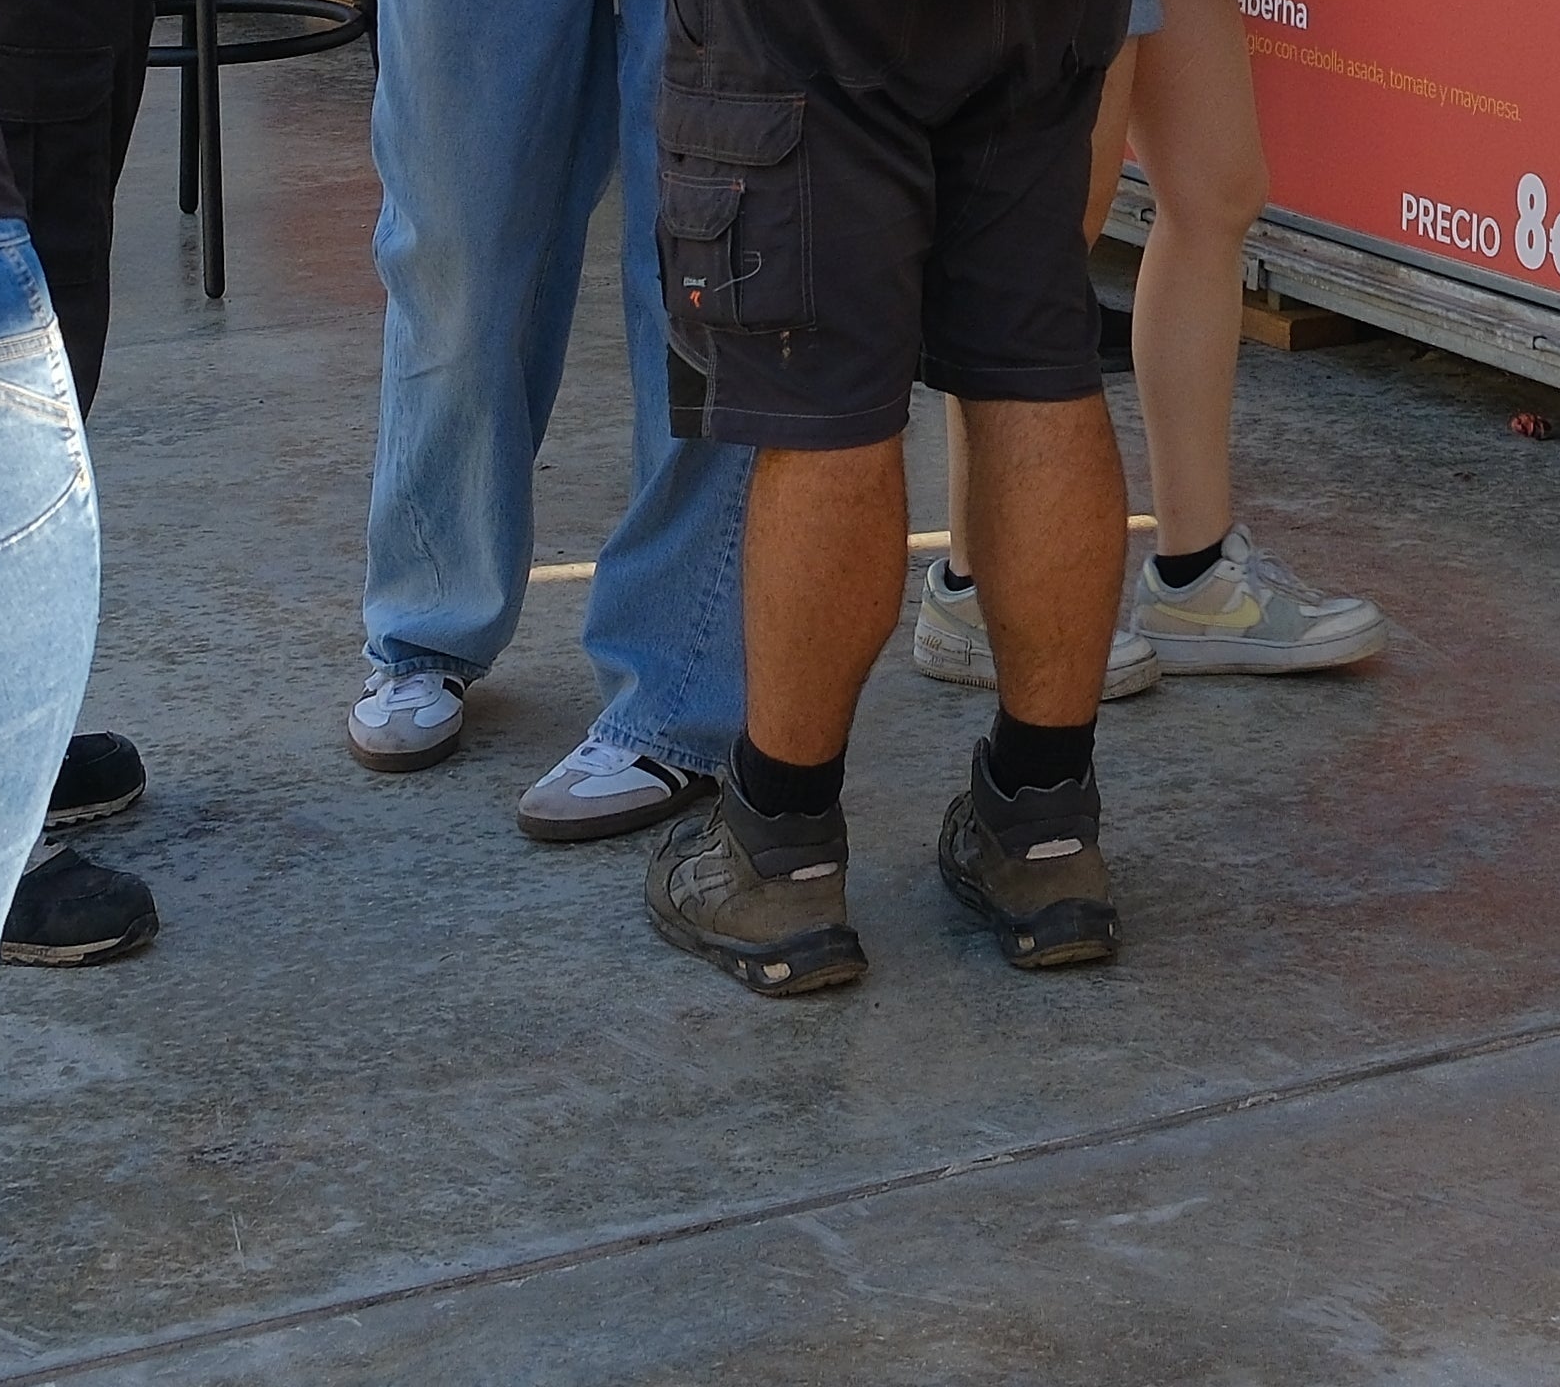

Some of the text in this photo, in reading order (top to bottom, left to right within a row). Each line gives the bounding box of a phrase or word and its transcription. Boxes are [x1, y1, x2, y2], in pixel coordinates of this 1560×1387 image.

[1275, 38, 1298, 61] con
[1300, 43, 1345, 74] cebolla
[1346, 54, 1387, 89] asada,
[1389, 69, 1437, 99] tomate
[1439, 84, 1447, 107] y
[1449, 86, 1523, 122] mayonesa.
[1401, 191, 1502, 258] PRECIO
